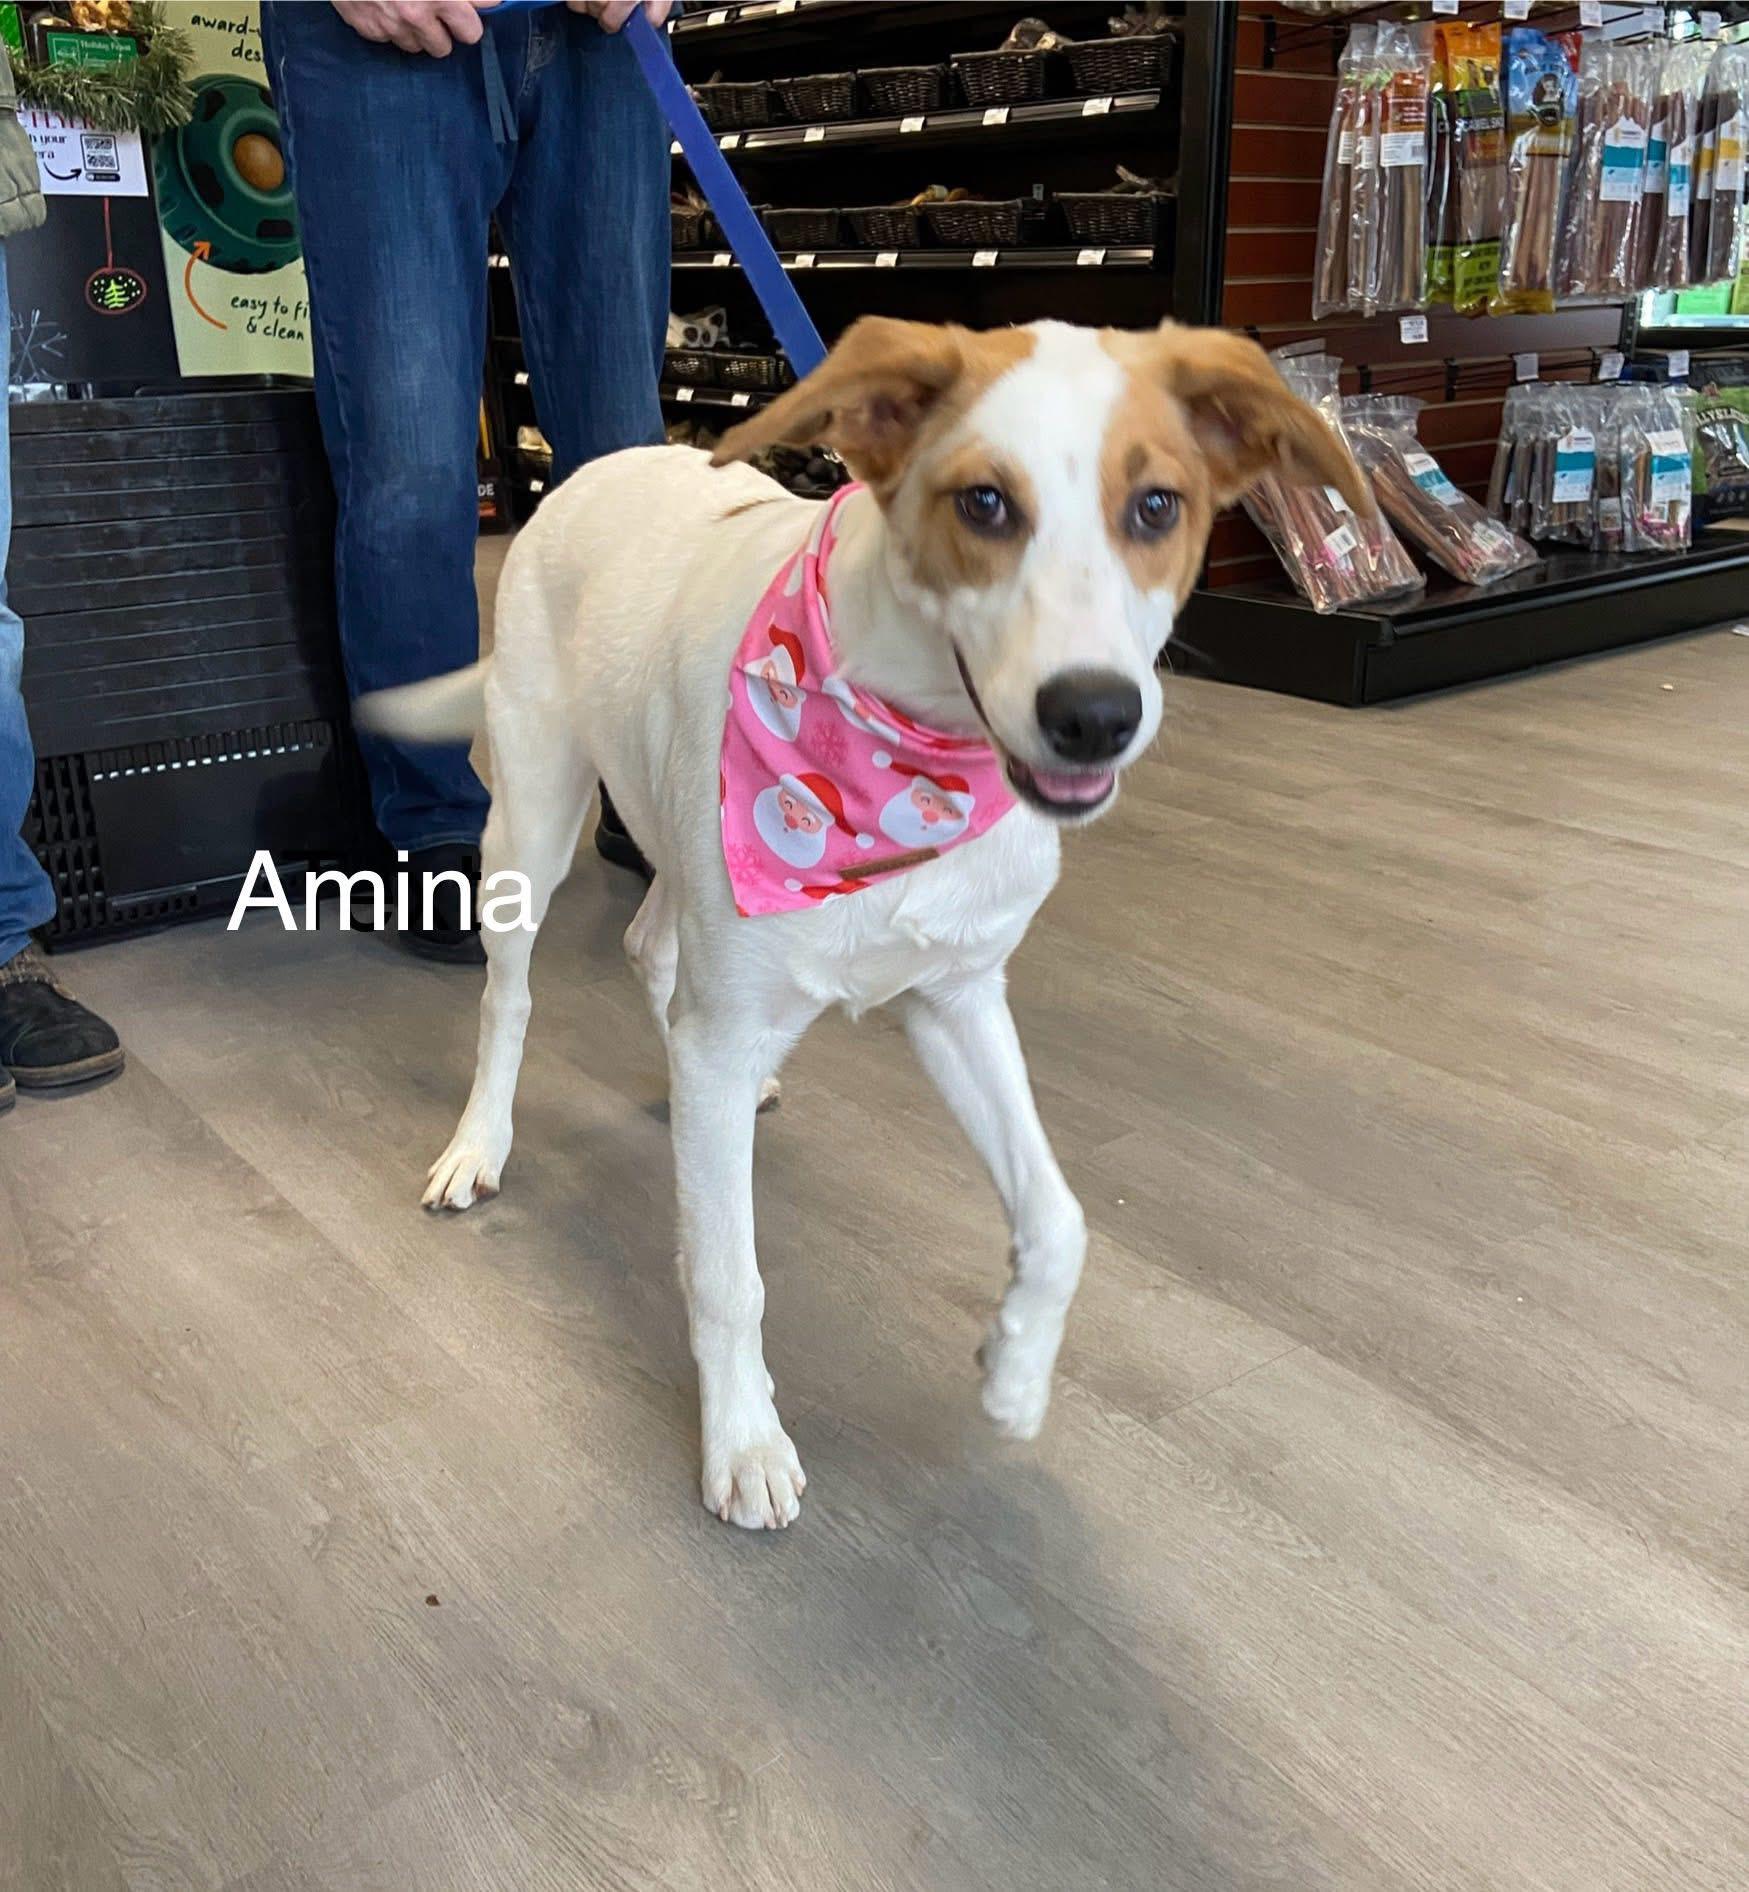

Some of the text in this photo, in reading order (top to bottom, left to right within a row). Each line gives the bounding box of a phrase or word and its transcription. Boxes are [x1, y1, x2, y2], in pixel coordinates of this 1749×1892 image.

[231, 296, 267, 319] easy
[274, 295, 288, 315] to
[246, 316, 304, 341] & clean
